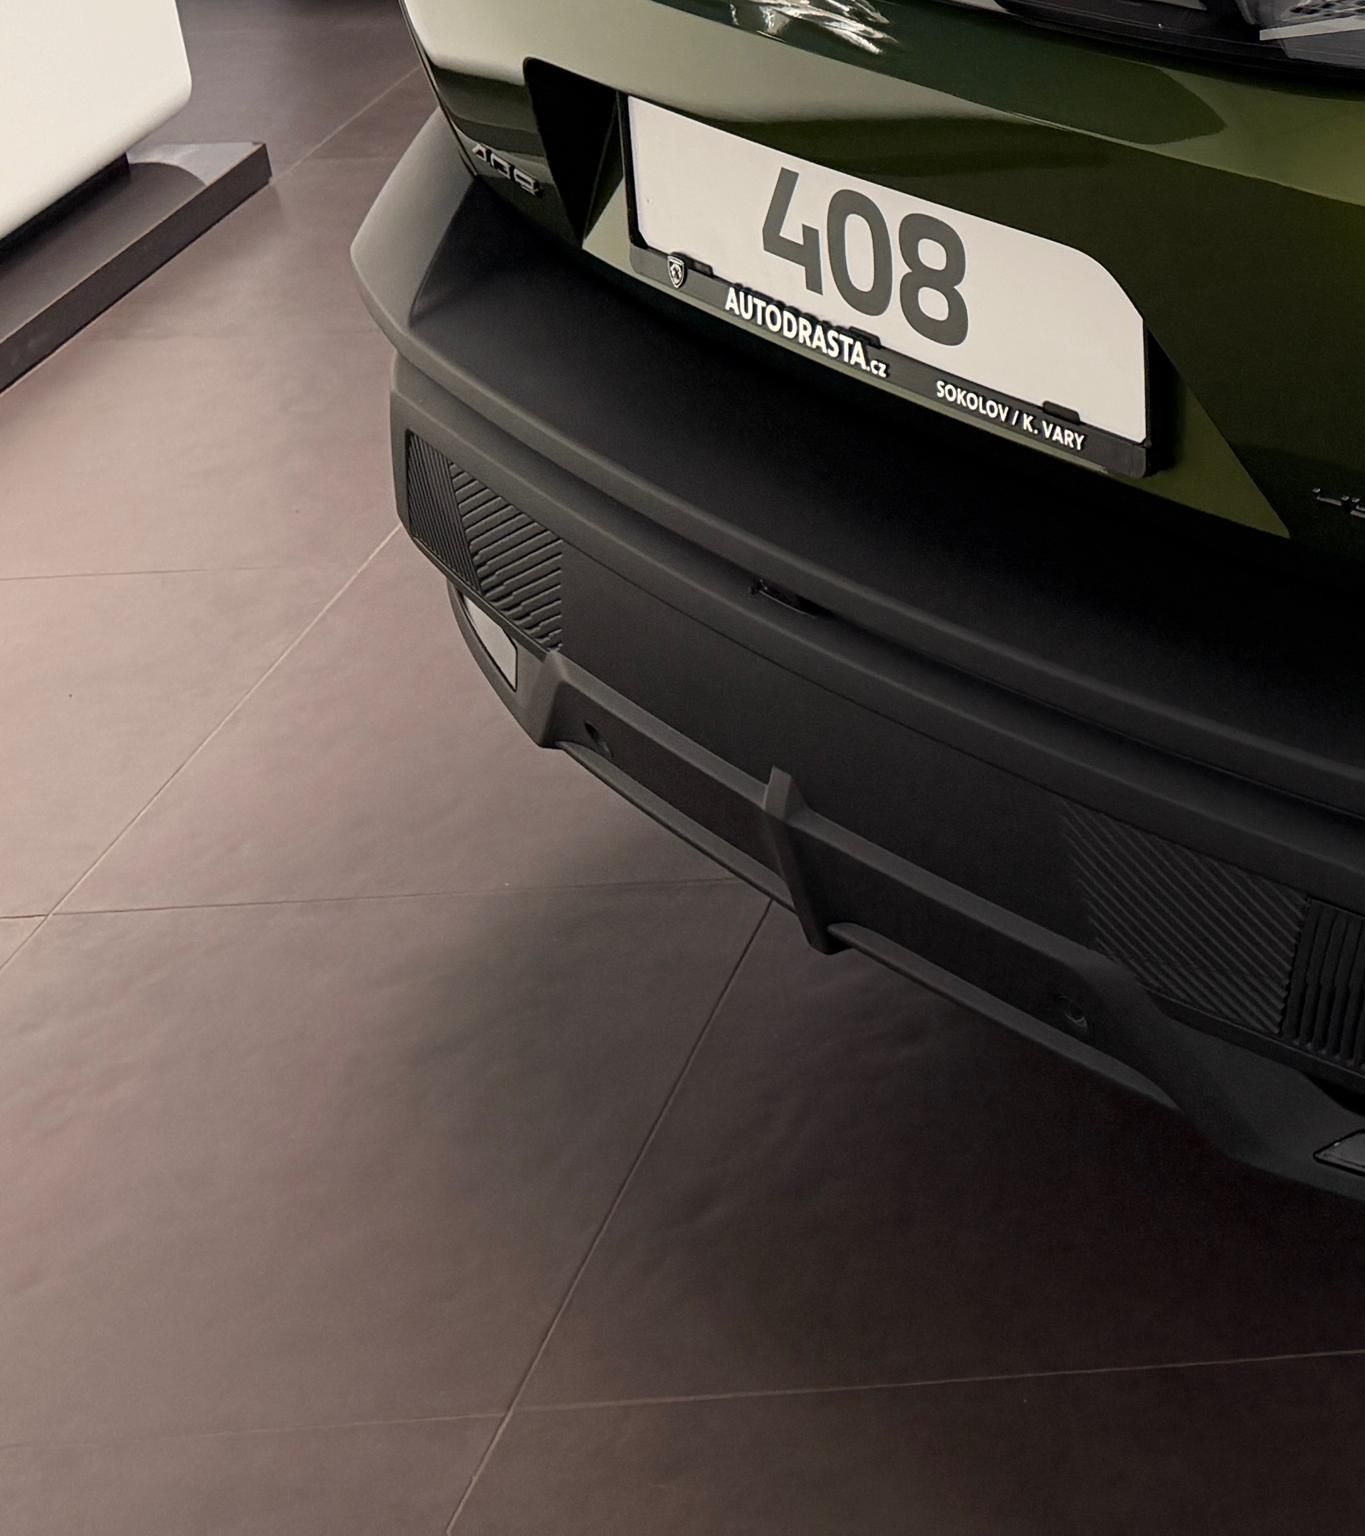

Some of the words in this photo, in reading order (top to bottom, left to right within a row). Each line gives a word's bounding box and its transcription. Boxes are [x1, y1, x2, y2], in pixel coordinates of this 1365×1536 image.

[762, 167, 968, 346] 408
[936, 379, 1010, 425] SOKOLOV
[1023, 415, 1040, 436] K.
[1042, 421, 1086, 452] VARY
